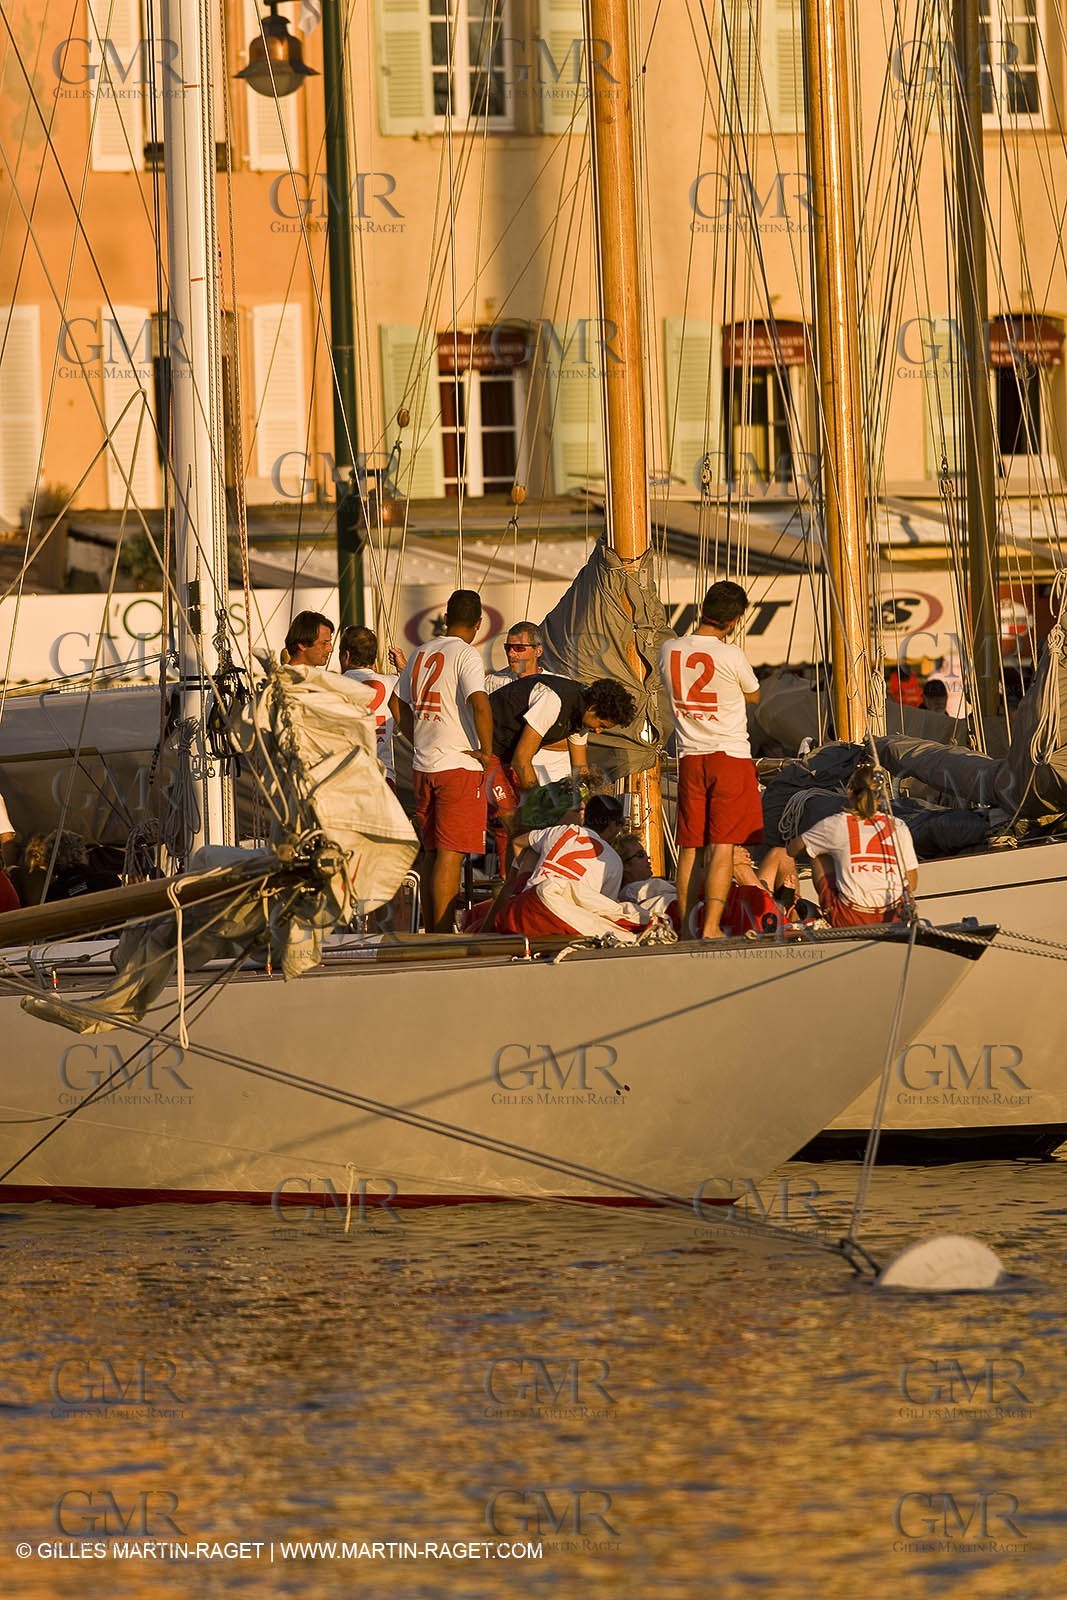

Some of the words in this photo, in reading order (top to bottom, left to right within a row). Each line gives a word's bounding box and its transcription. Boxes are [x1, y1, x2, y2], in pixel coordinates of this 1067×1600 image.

[411, 651, 445, 704] 12
[670, 650, 717, 704] 12
[675, 711, 719, 722] IKRA
[545, 827, 604, 877] 12
[846, 815, 896, 857] 12
[851, 864, 896, 875] IKRA
